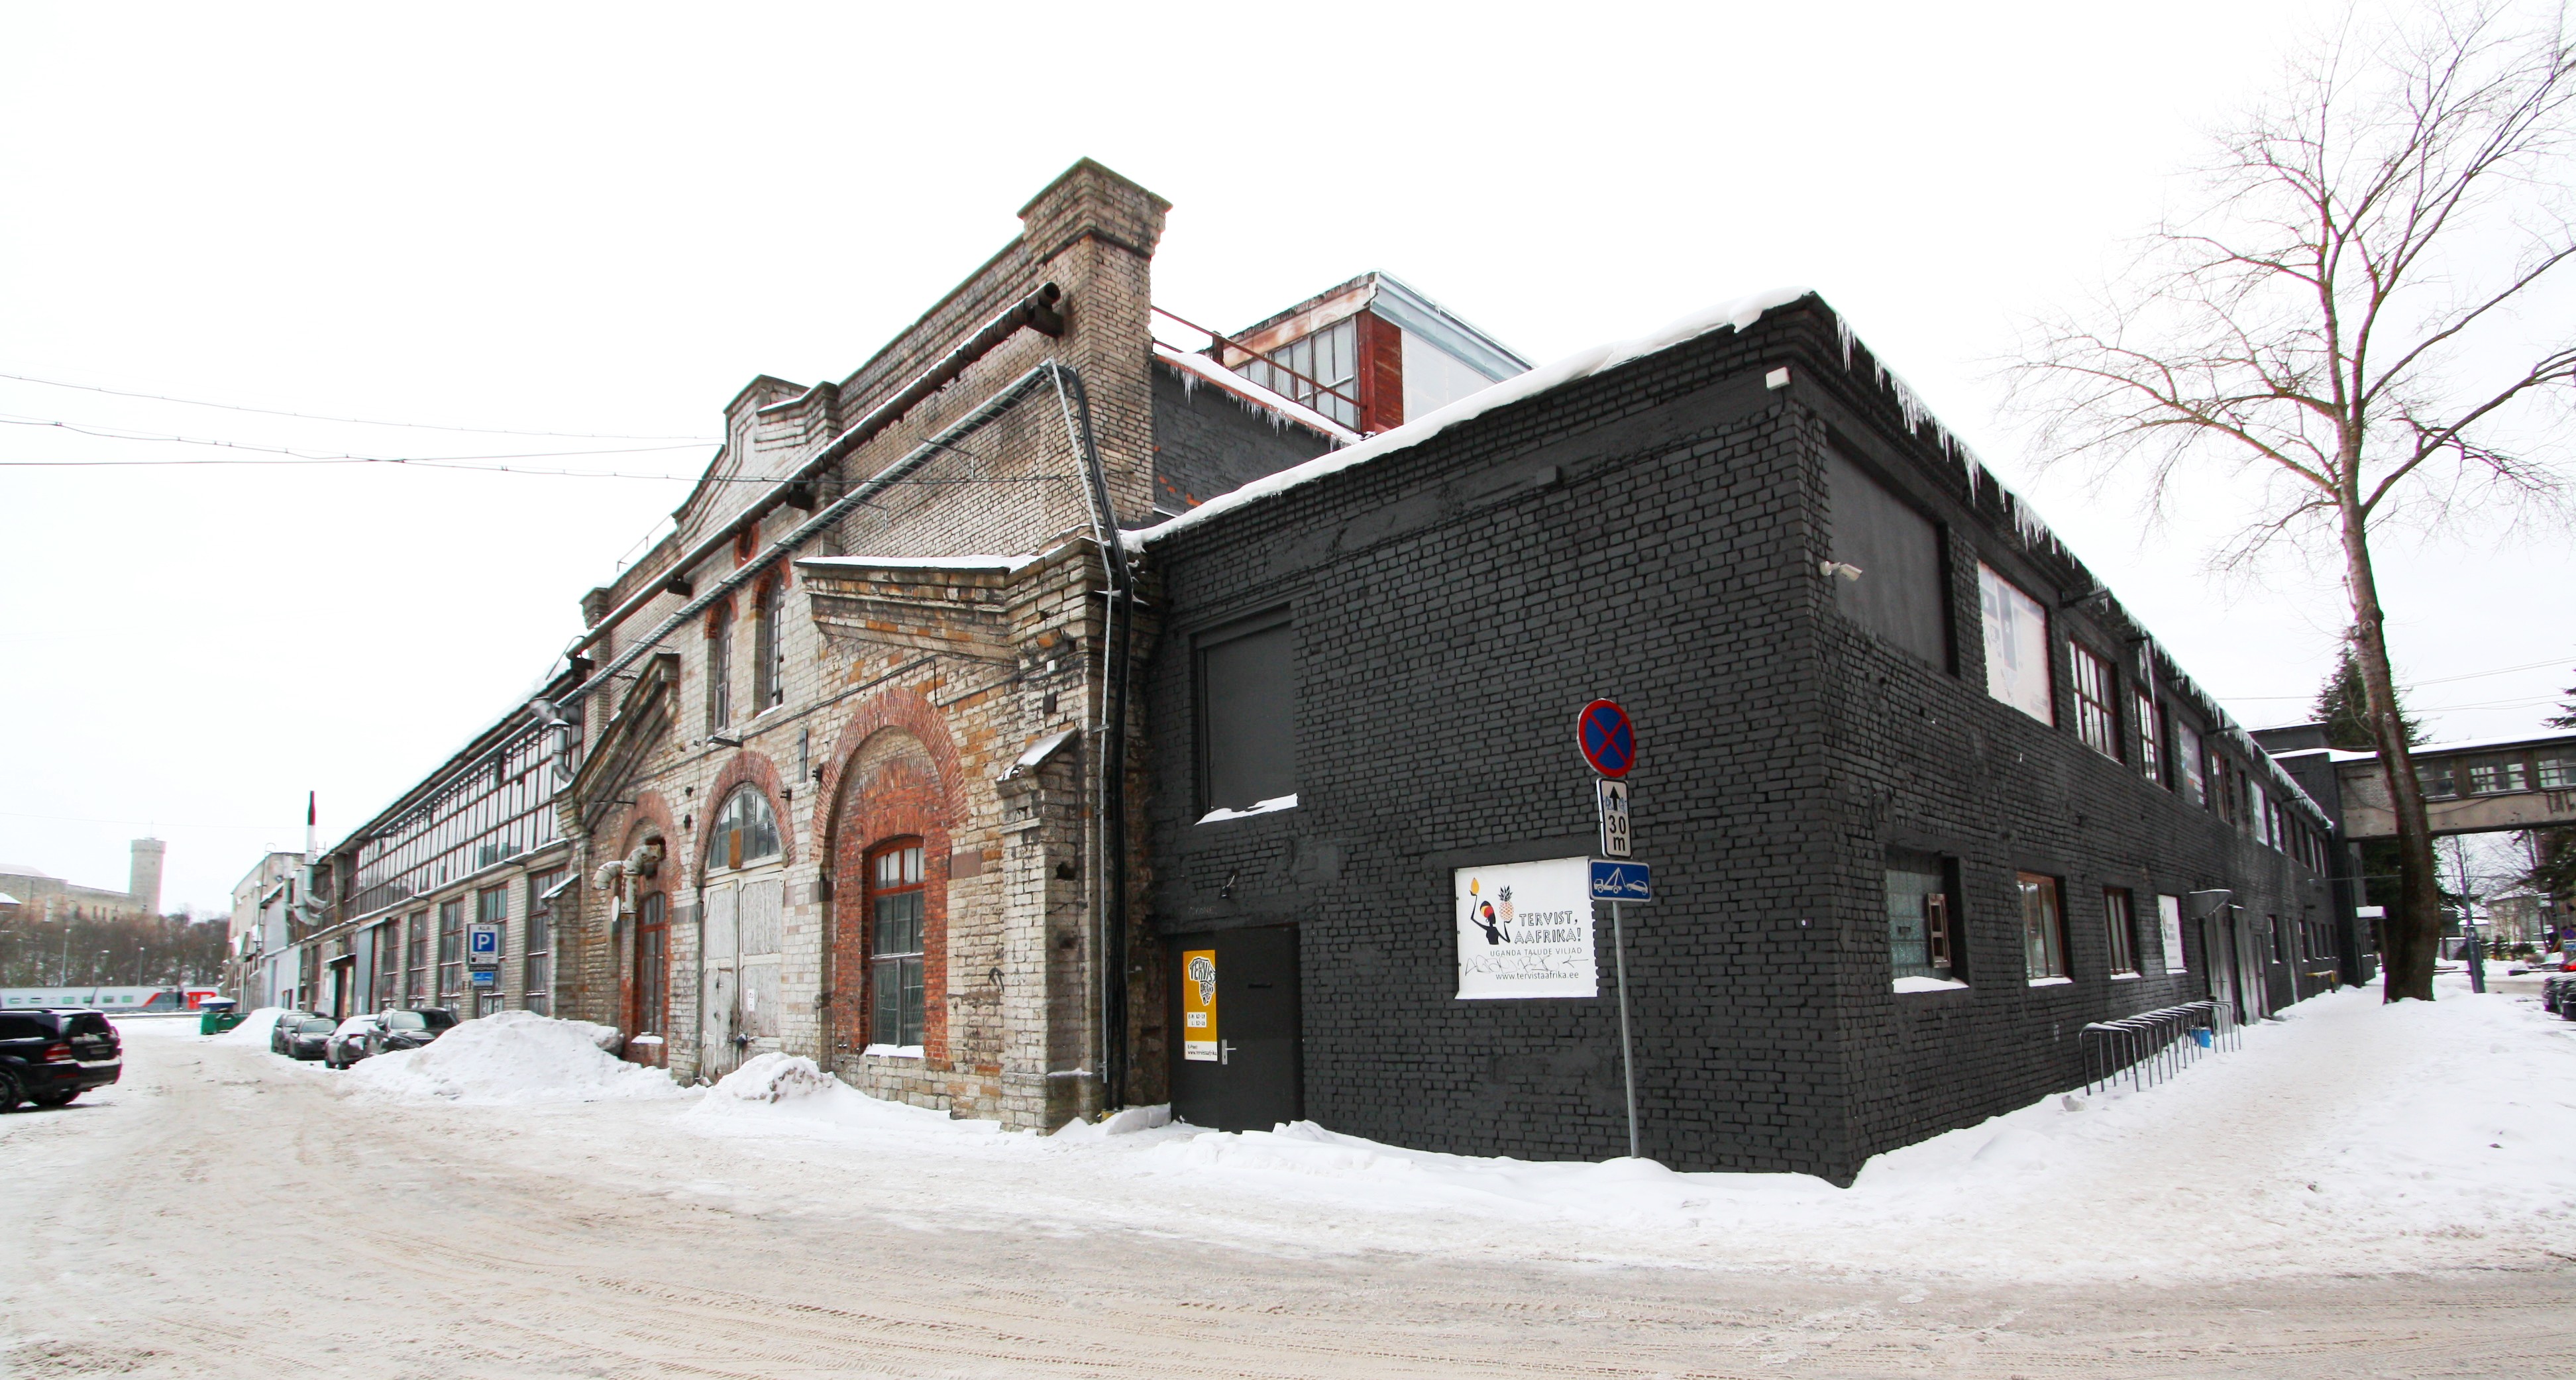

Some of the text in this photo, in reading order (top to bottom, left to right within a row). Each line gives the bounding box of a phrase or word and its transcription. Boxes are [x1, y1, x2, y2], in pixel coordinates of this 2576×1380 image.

[1609, 815, 1626, 835] 30
[1613, 836, 1625, 851] m
[1519, 911, 1578, 927] TERVIST,
[478, 933, 490, 950] P
[1515, 928, 1582, 944] AAFRIKA!
[1495, 971, 1579, 980] www.tervistaafrika.ee
